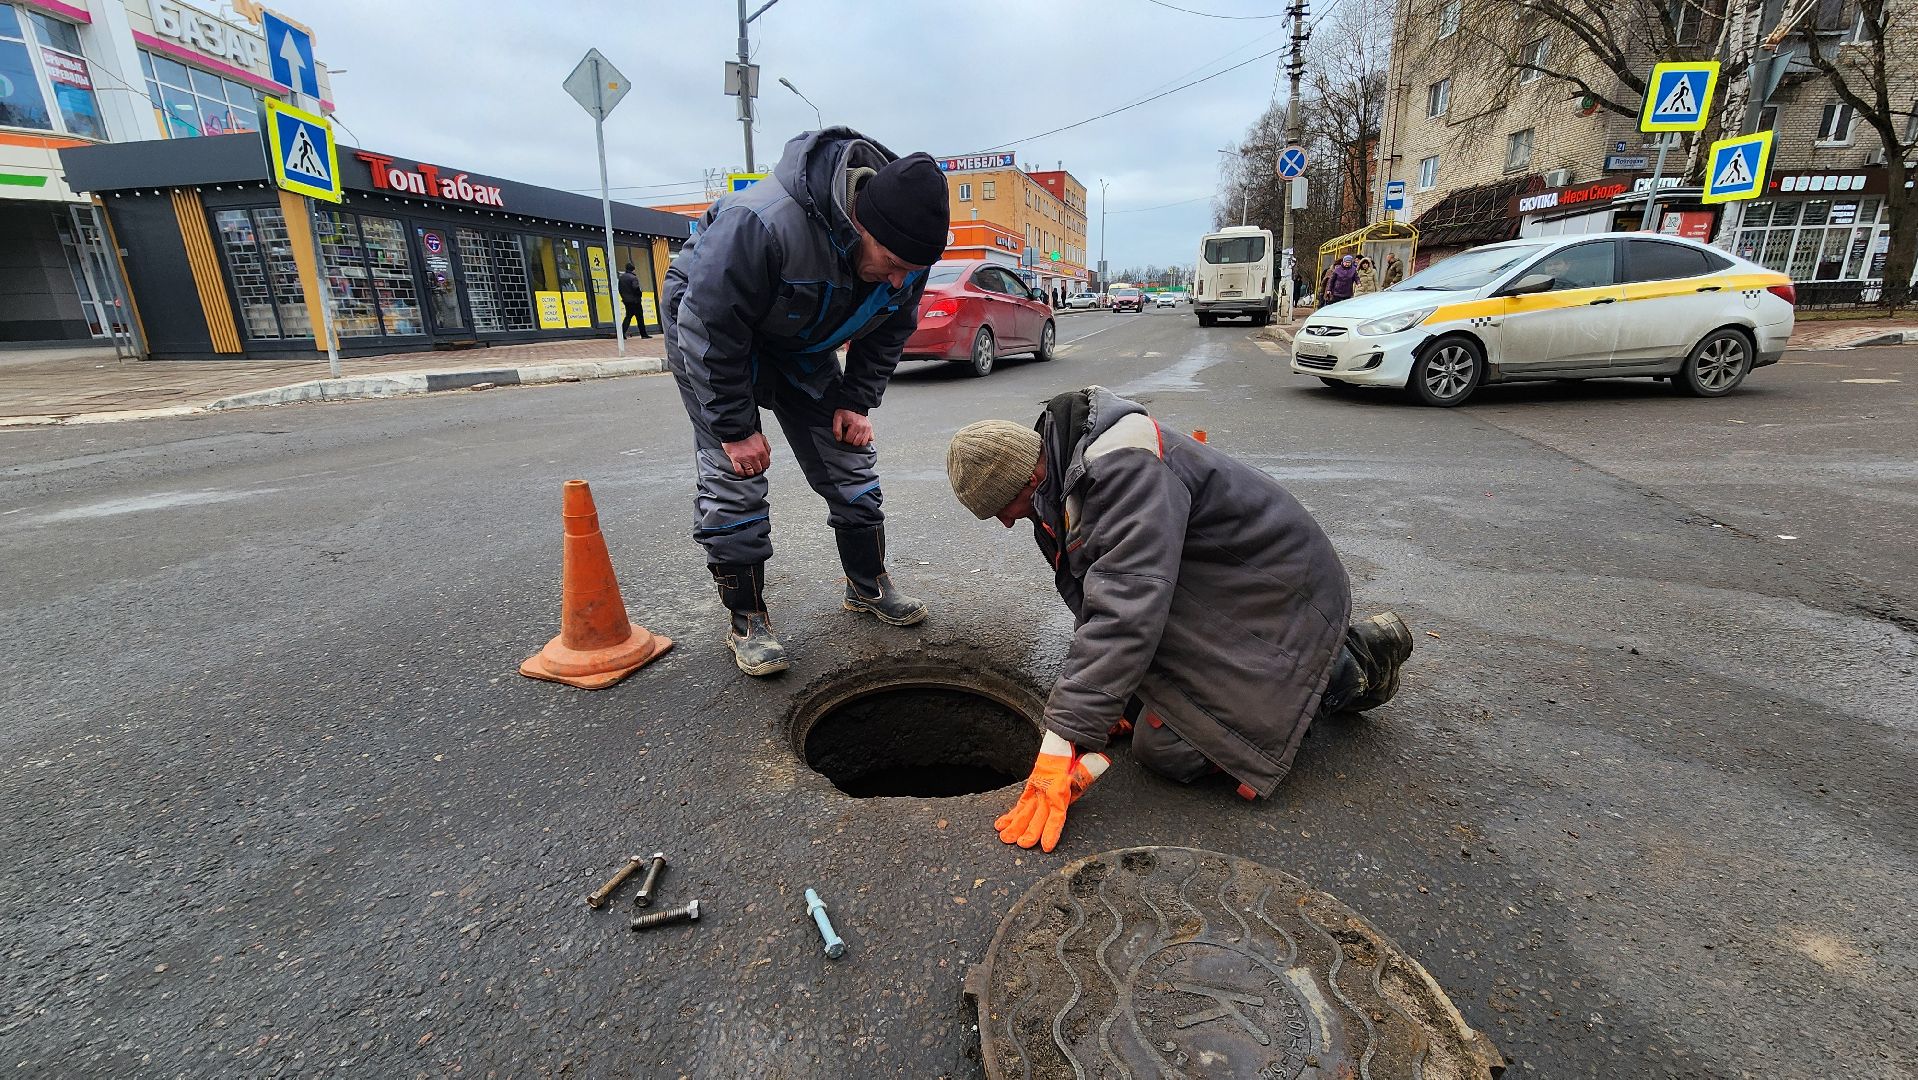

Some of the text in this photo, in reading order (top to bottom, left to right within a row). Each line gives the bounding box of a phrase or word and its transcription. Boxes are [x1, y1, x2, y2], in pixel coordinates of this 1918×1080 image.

[148, 0, 262, 68] БАЗАР
[1617, 143, 1625, 151] 21
[957, 155, 1004, 170] МЕБЕЛЬ
[1519, 192, 1559, 212] СКУПКА
